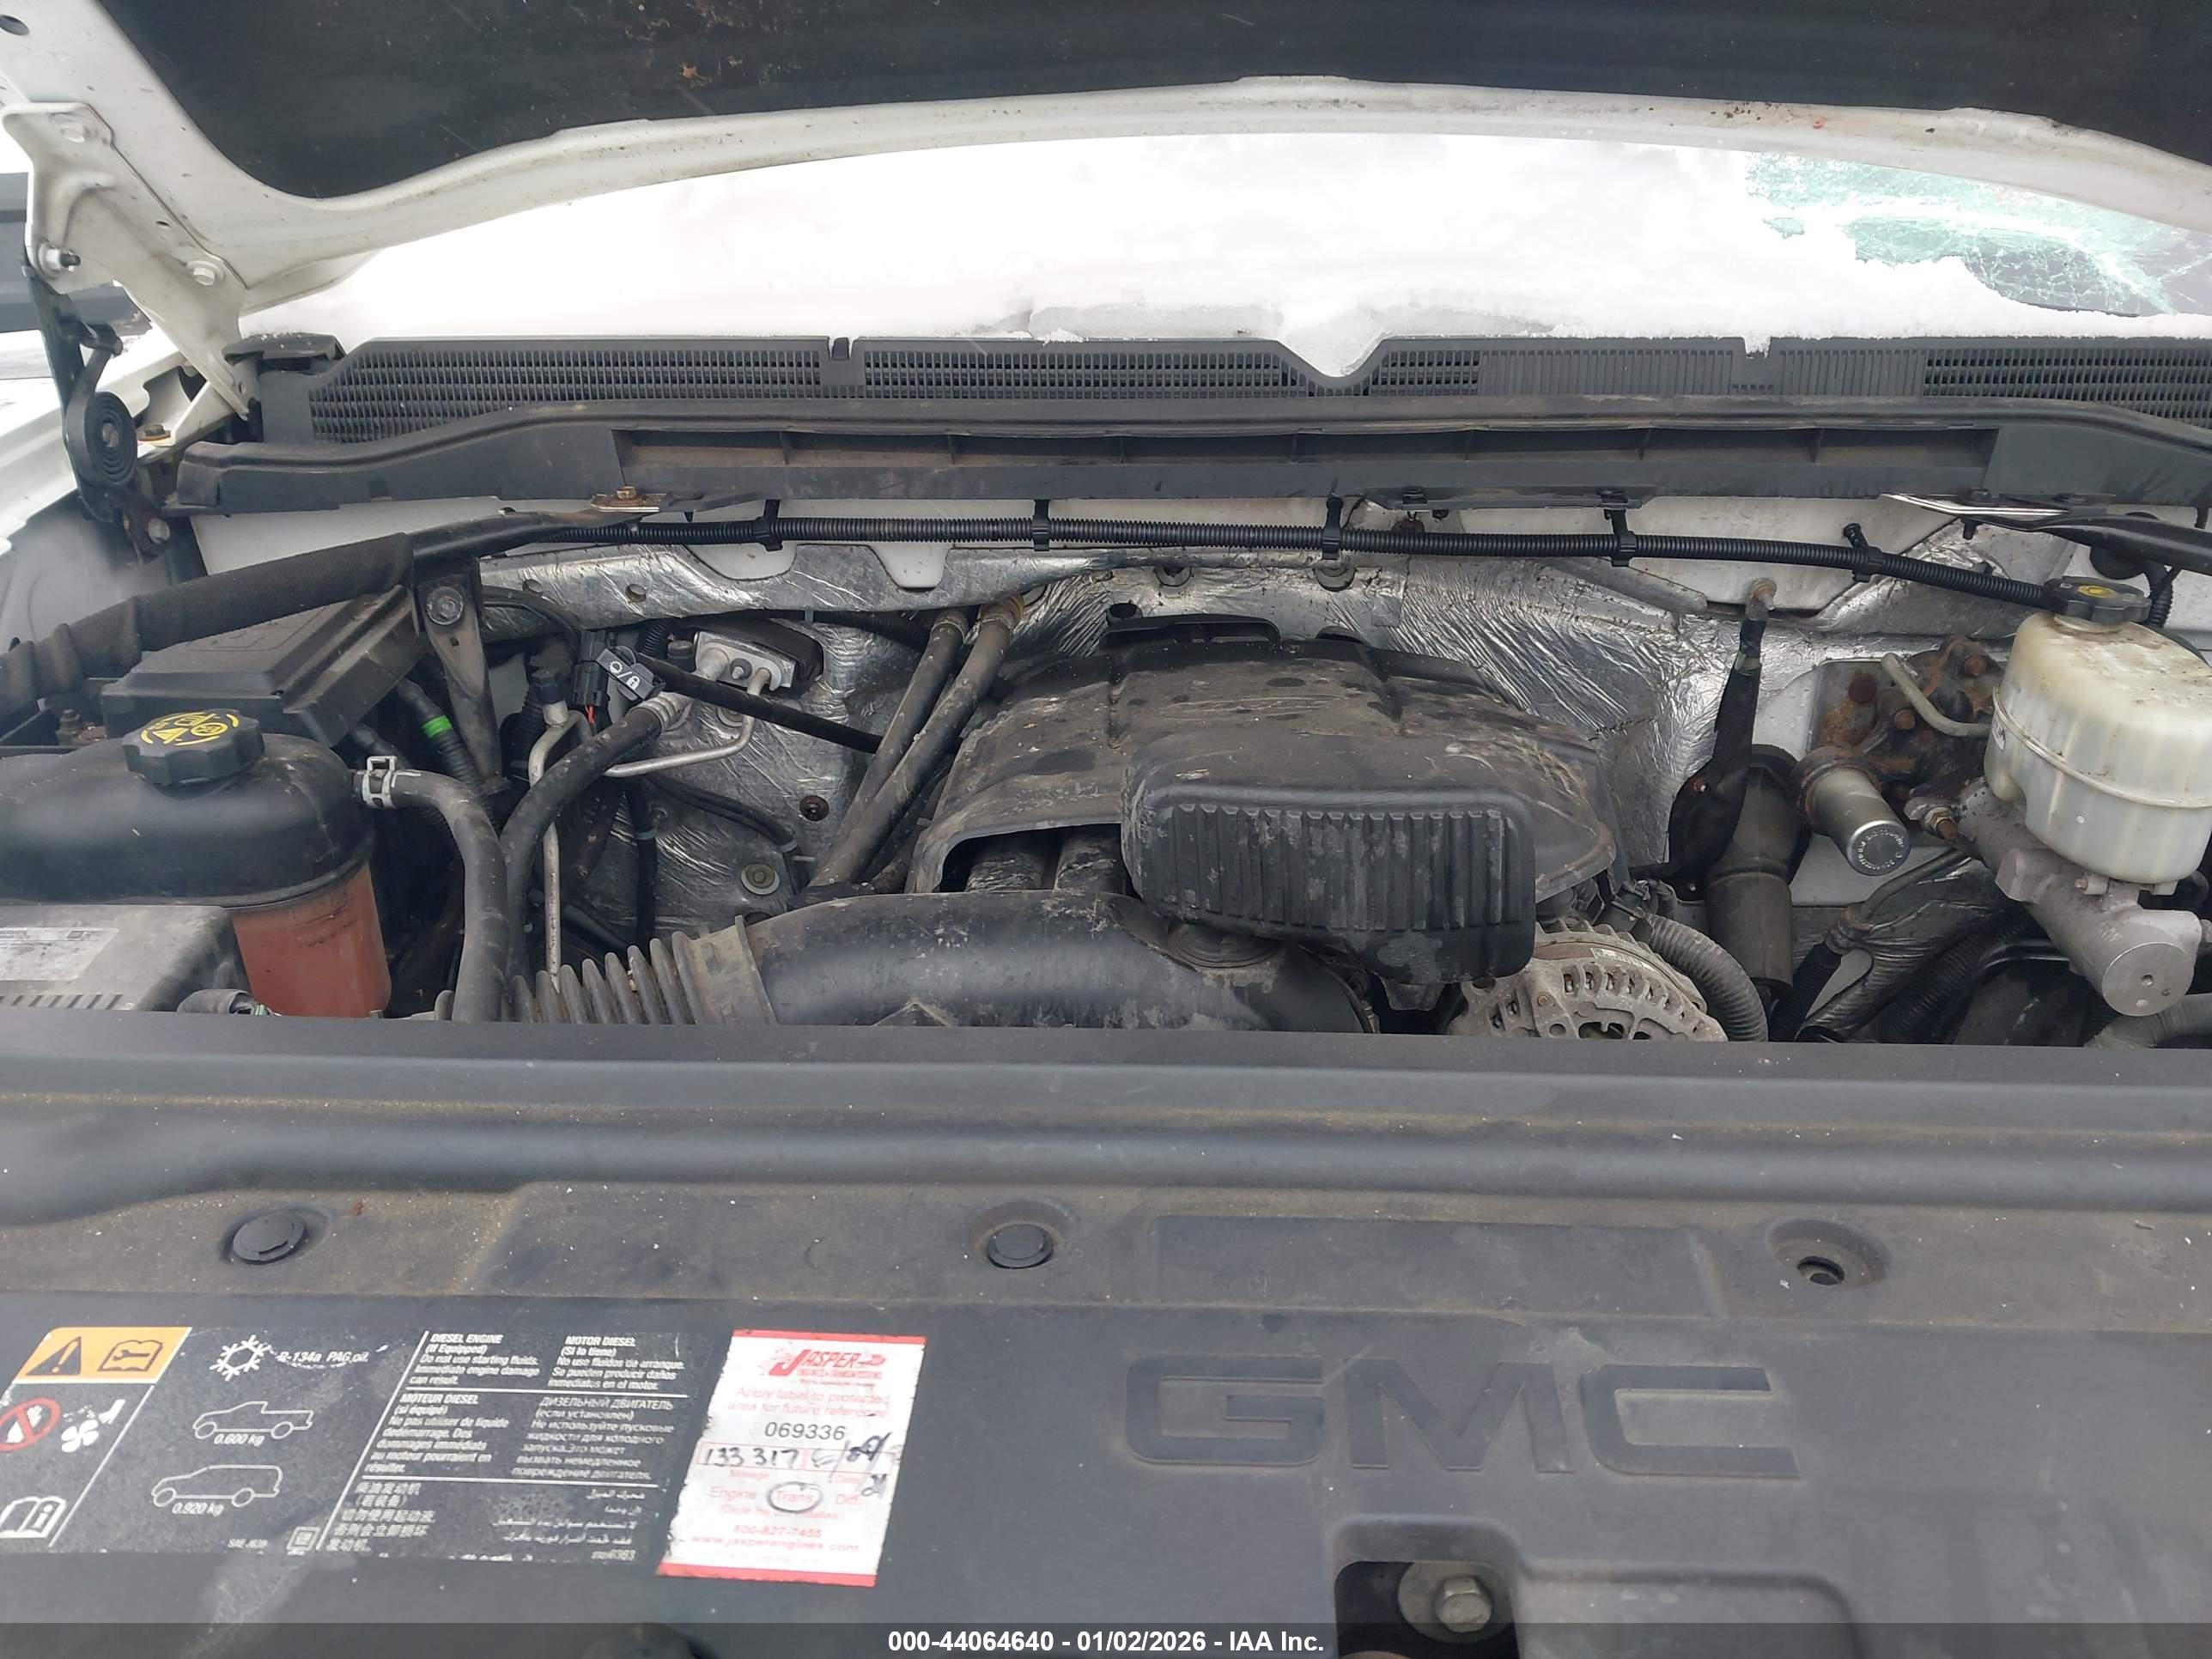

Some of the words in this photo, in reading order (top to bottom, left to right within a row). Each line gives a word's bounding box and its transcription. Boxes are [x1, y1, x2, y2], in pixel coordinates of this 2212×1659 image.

[430, 1334, 464, 1343] DIESEL
[465, 1334, 504, 1344] ENGINE
[565, 1336, 601, 1346] MOTOR
[602, 1337, 635, 1346] DIESEL
[419, 1354, 434, 1364] Do
[434, 1355, 451, 1364] not
[471, 1355, 509, 1365] starting
[769, 1349, 862, 1376] JASPER
[466, 1367, 500, 1376] engine
[501, 1366, 540, 1377] damage
[399, 1394, 444, 1404] MOTEUR
[444, 1395, 479, 1405] DIESEL
[611, 1399, 674, 1411] ДВИГАТЕЛЬ
[1125, 1355, 1802, 1480] GMC
[764, 1421, 847, 1441] 069336
[213, 1433, 249, 1444] 0.600
[247, 1434, 265, 1447] kg
[708, 1486, 757, 1500] Engine
[775, 1490, 814, 1503] Trans
[172, 1502, 208, 1514] 0.920
[206, 1503, 224, 1516] kg
